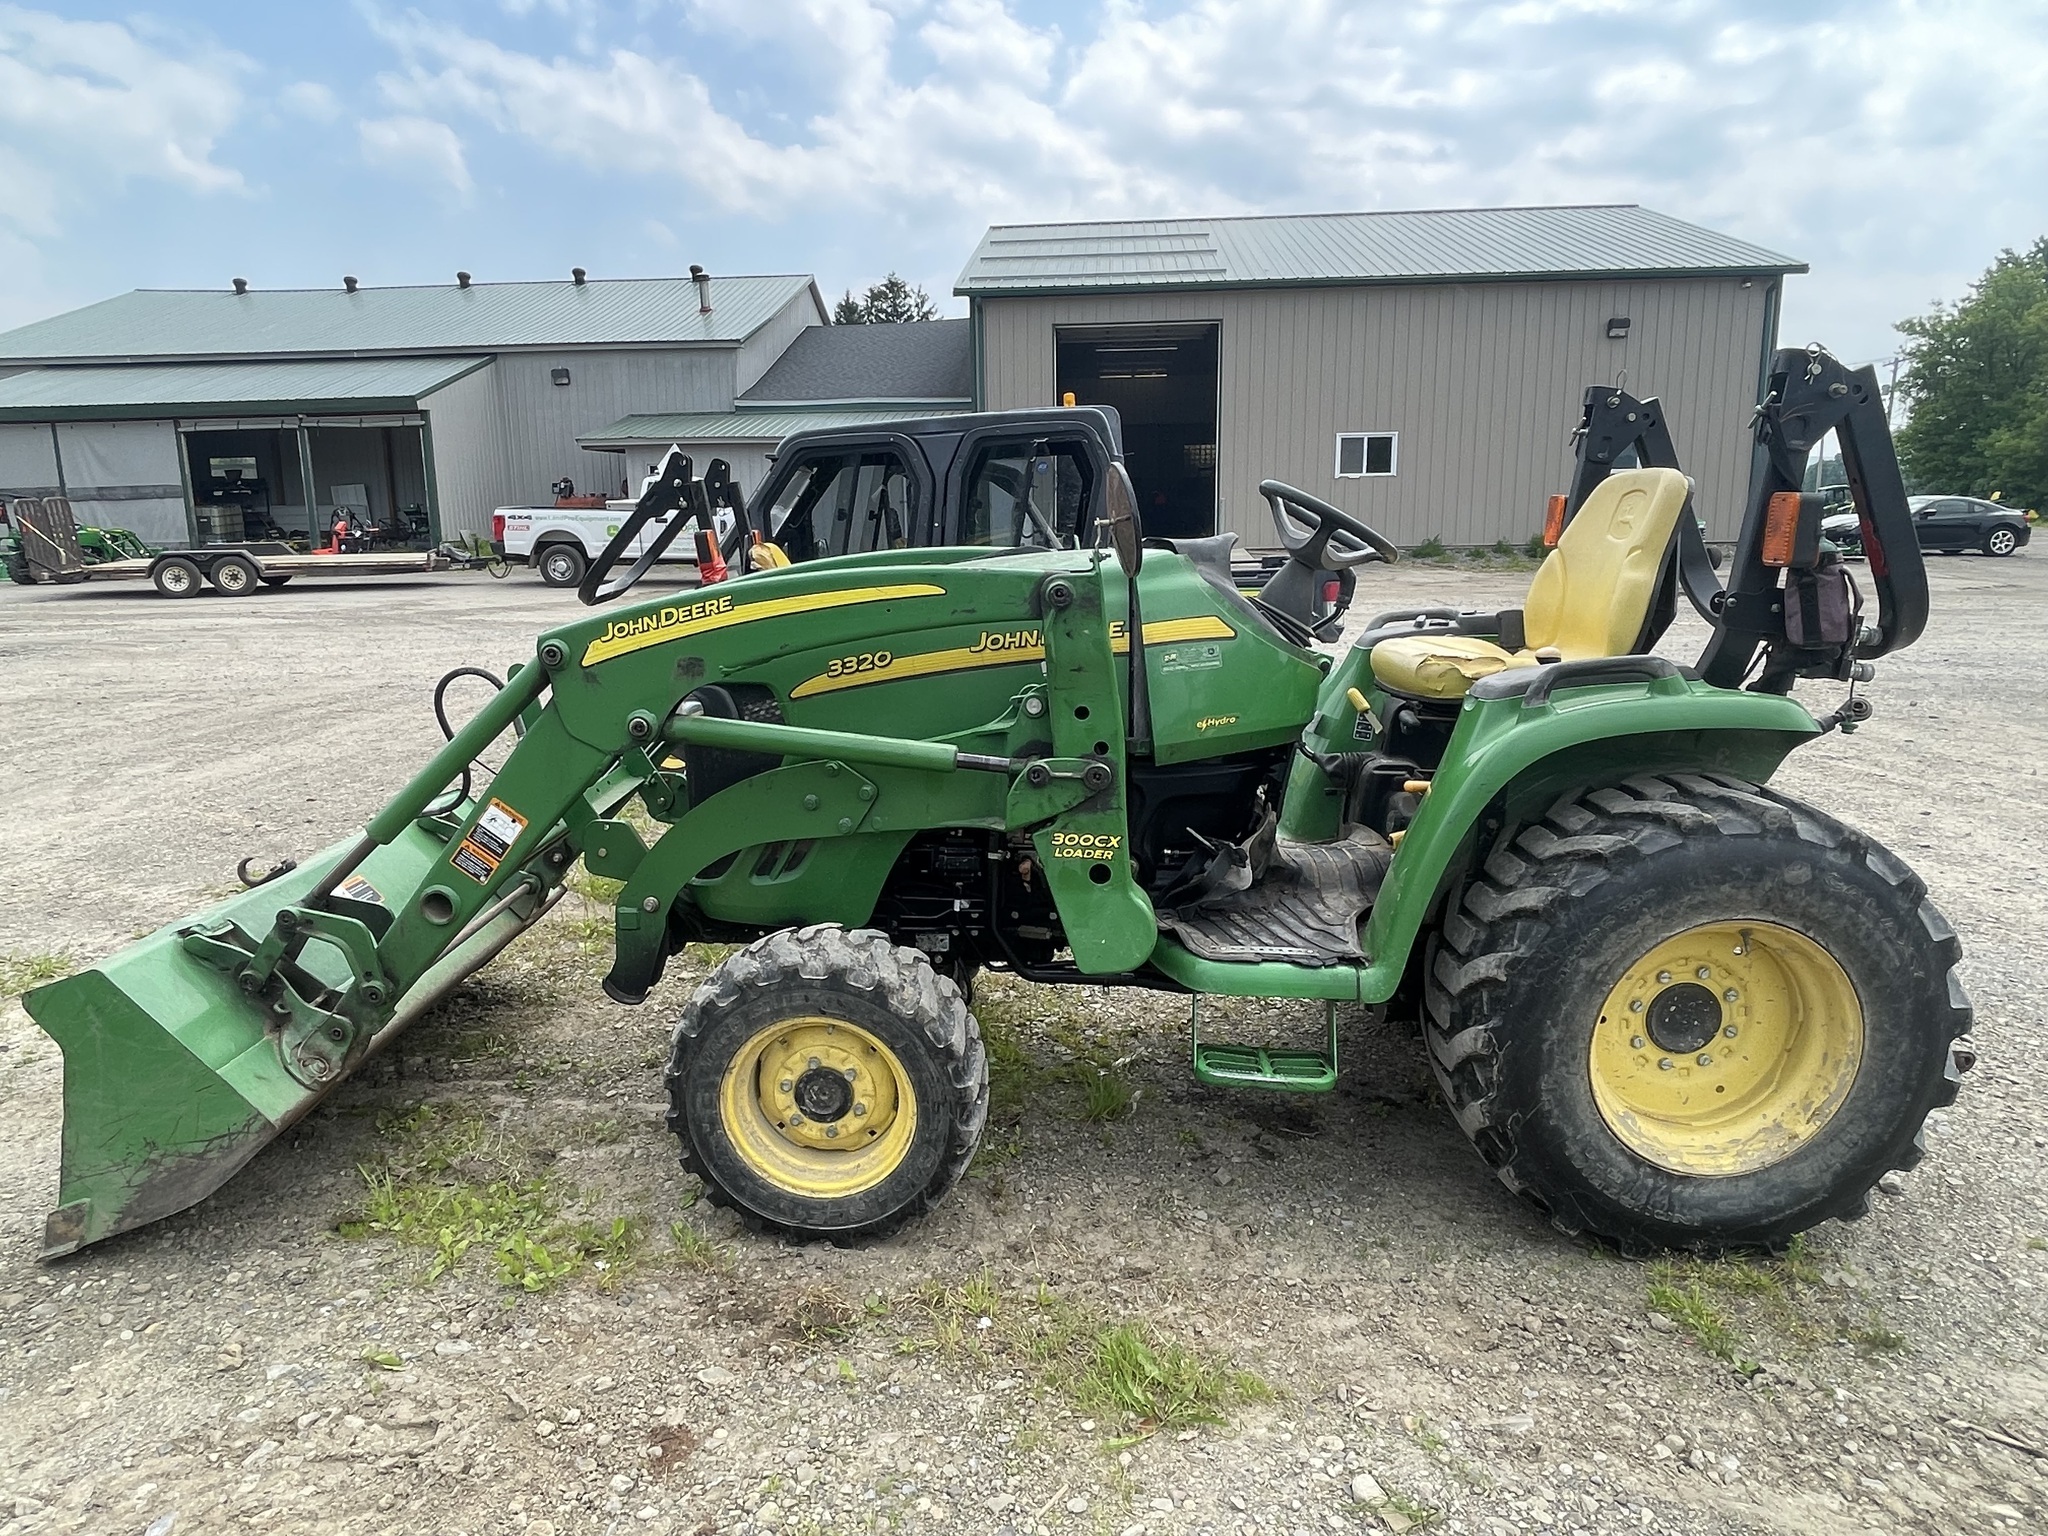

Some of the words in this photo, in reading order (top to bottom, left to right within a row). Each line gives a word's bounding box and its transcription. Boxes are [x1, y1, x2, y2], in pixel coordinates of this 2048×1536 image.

[600, 613, 659, 641] JOHN
[659, 595, 733, 627] DEERE
[970, 629, 1038, 652] JOHN
[827, 651, 892, 677] 3320
[1051, 832, 1121, 848] 300CX
[1054, 847, 1114, 860] LOADER
